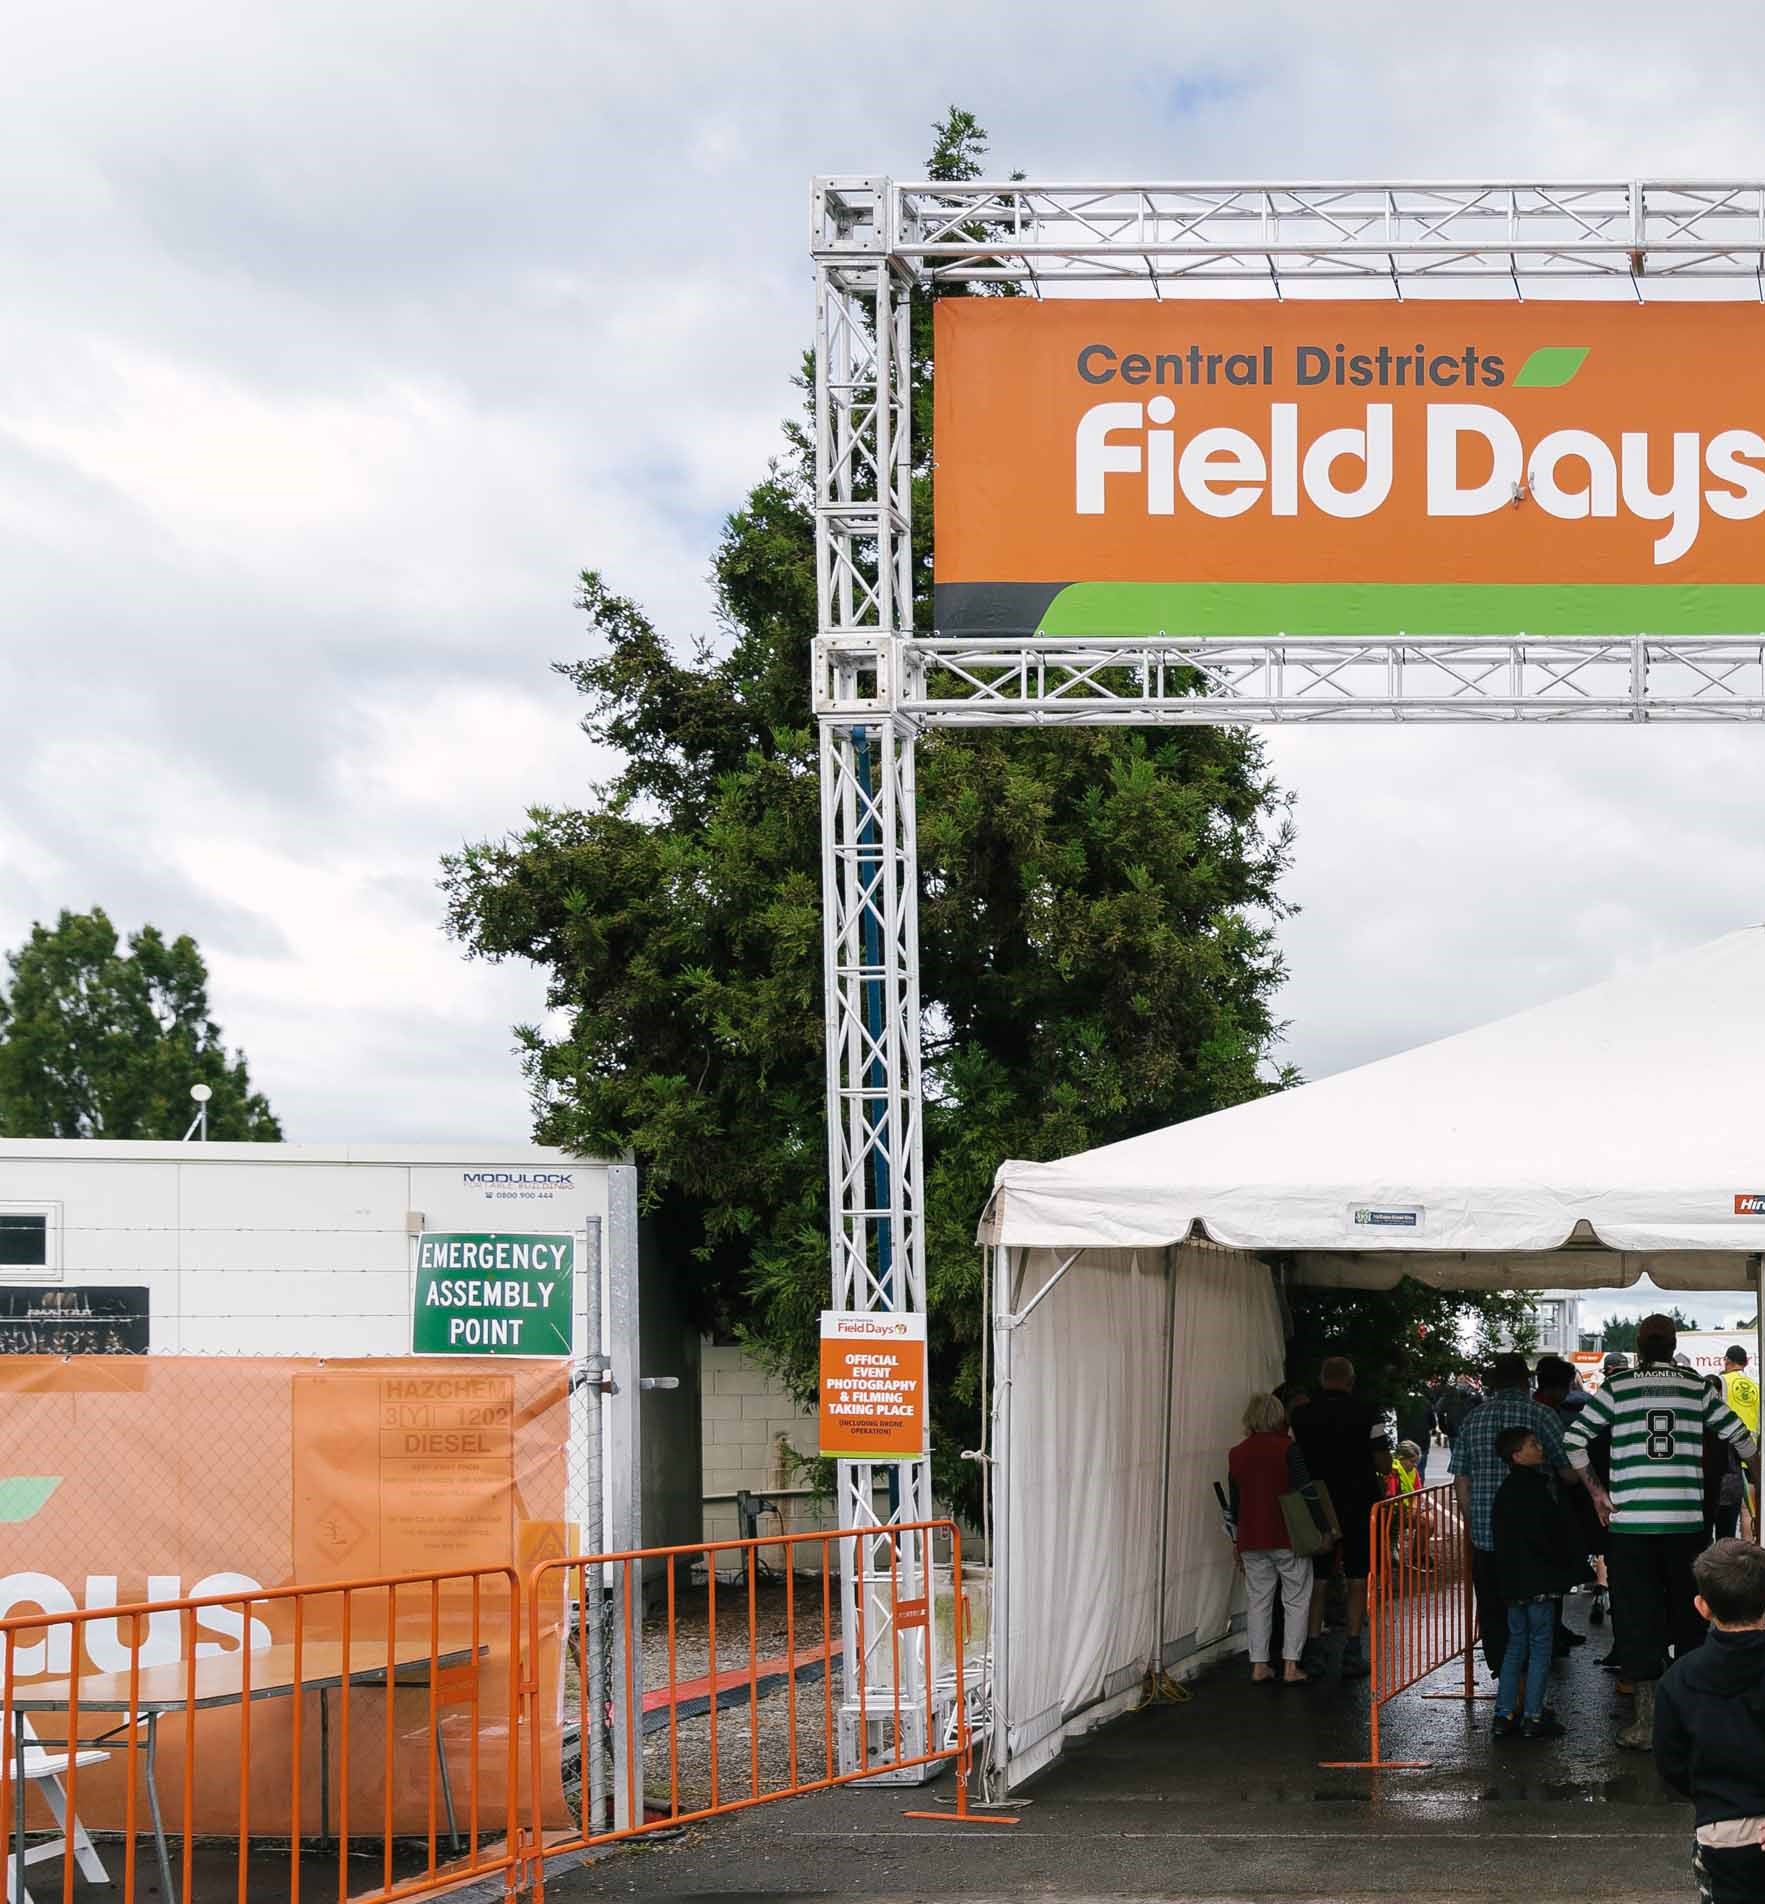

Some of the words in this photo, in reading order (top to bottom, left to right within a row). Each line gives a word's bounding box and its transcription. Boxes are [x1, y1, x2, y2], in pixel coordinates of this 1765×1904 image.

[1077, 344, 1273, 386] Central
[1296, 343, 1505, 387] Districts
[1075, 395, 1393, 518] Field
[464, 1173, 574, 1183] MODULOCK
[421, 1242, 567, 1270] EMERGENCY
[425, 1280, 555, 1308] ASSEMBLY
[449, 1318, 524, 1345] POINT
[837, 1322, 864, 1333] Field
[866, 1322, 894, 1336] Days
[845, 1353, 899, 1366] OFFICIAL
[852, 1367, 892, 1378] EVENT
[386, 1380, 506, 1400] HAZCHEM
[826, 1378, 917, 1391] PHOTOGRAPHY
[840, 1391, 849, 1402] &
[852, 1391, 904, 1403] FILMING
[456, 1406, 509, 1426] 1202
[828, 1403, 873, 1415] TAKING
[876, 1404, 915, 1416] PLACE
[405, 1434, 492, 1453] DIESEL
[1647, 1408, 1676, 1460] 8
